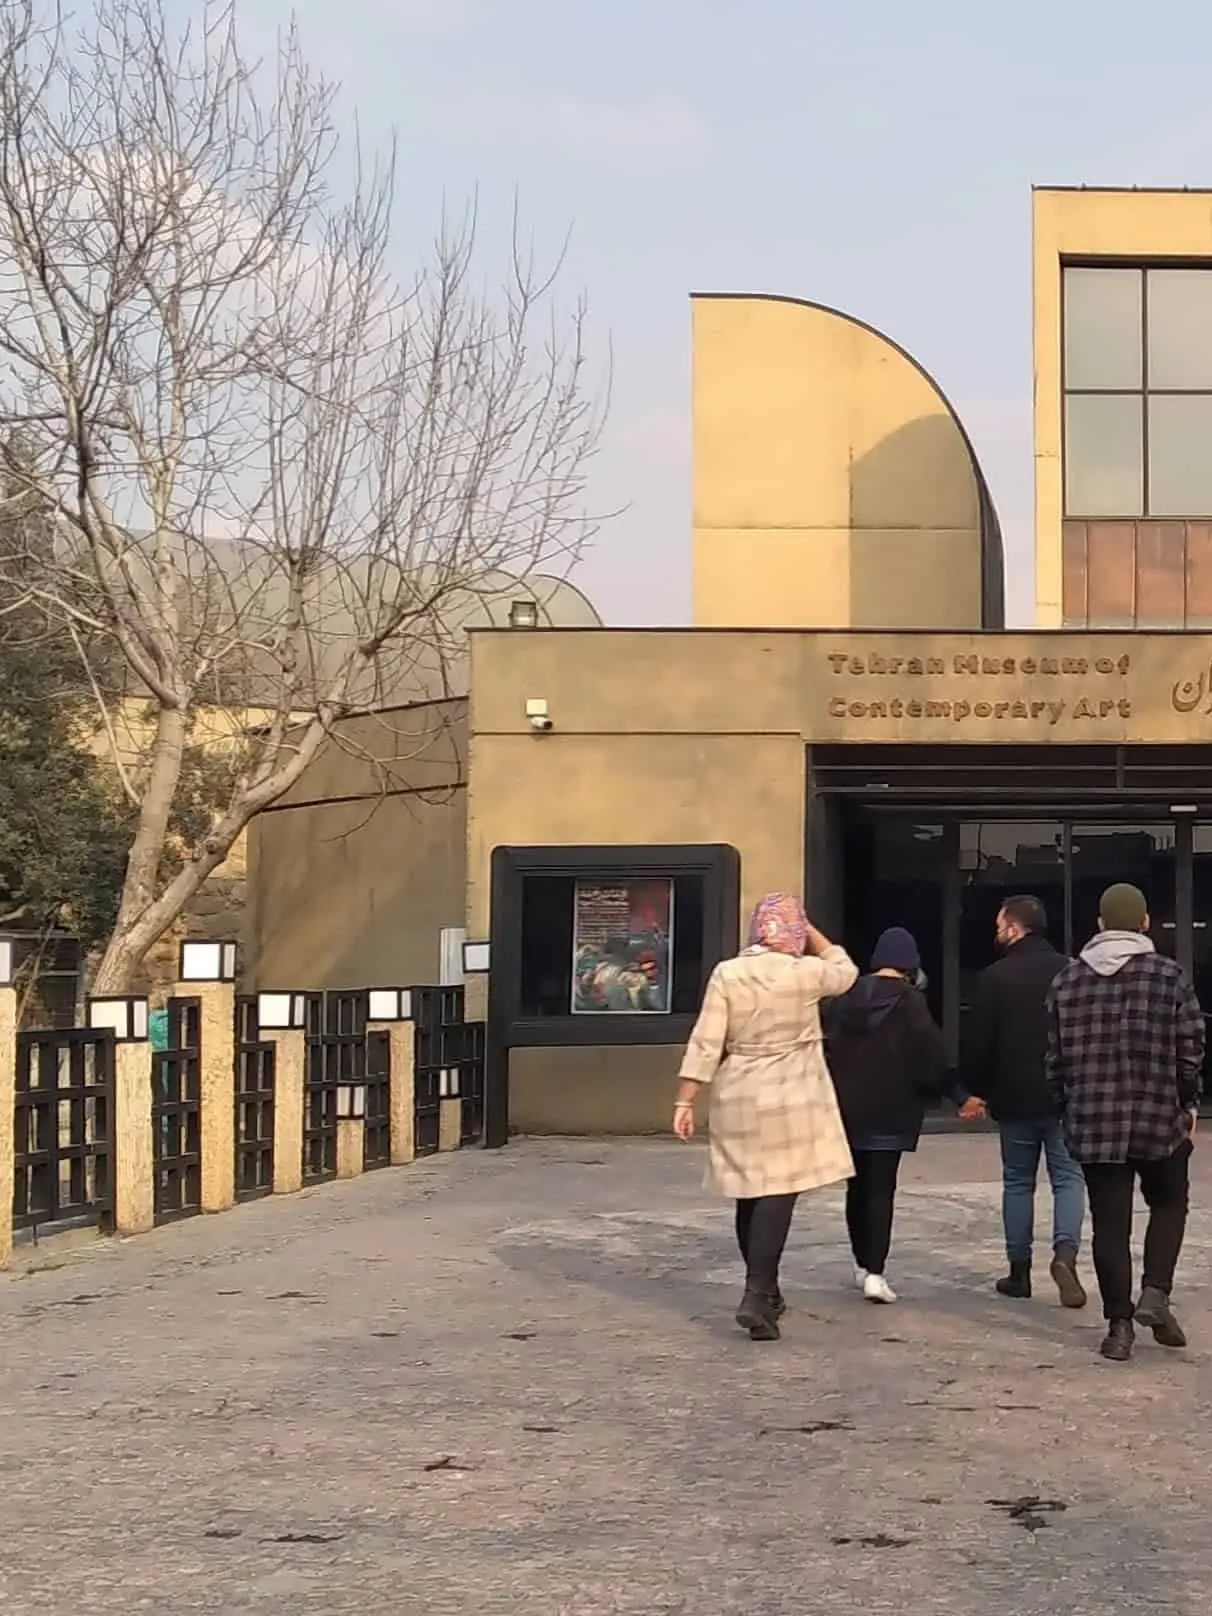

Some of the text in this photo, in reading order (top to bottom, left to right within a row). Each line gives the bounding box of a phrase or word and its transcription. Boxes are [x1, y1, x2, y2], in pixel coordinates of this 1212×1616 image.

[828, 652, 1130, 675] Tehran Museum of
[829, 697, 1131, 725] Contemporary Art
